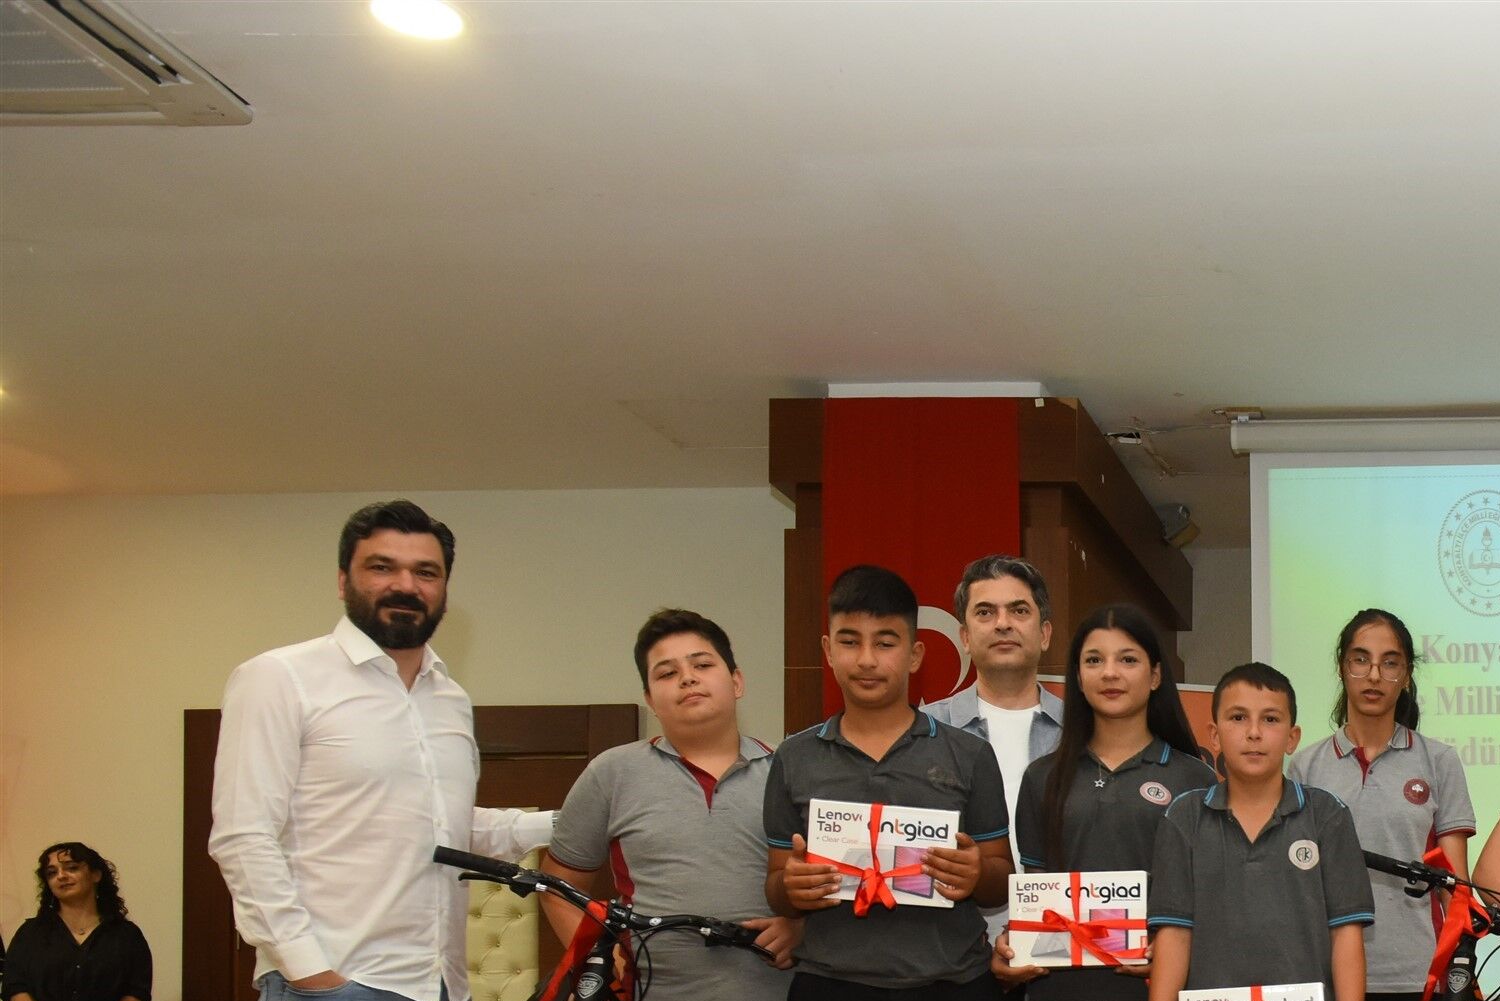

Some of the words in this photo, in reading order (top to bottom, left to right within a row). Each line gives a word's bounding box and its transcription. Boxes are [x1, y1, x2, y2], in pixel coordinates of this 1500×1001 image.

[817, 808, 863, 821] Lenov
[816, 821, 842, 833] Tab
[867, 818, 949, 842] ntgiad
[1016, 892, 1039, 903] Tab
